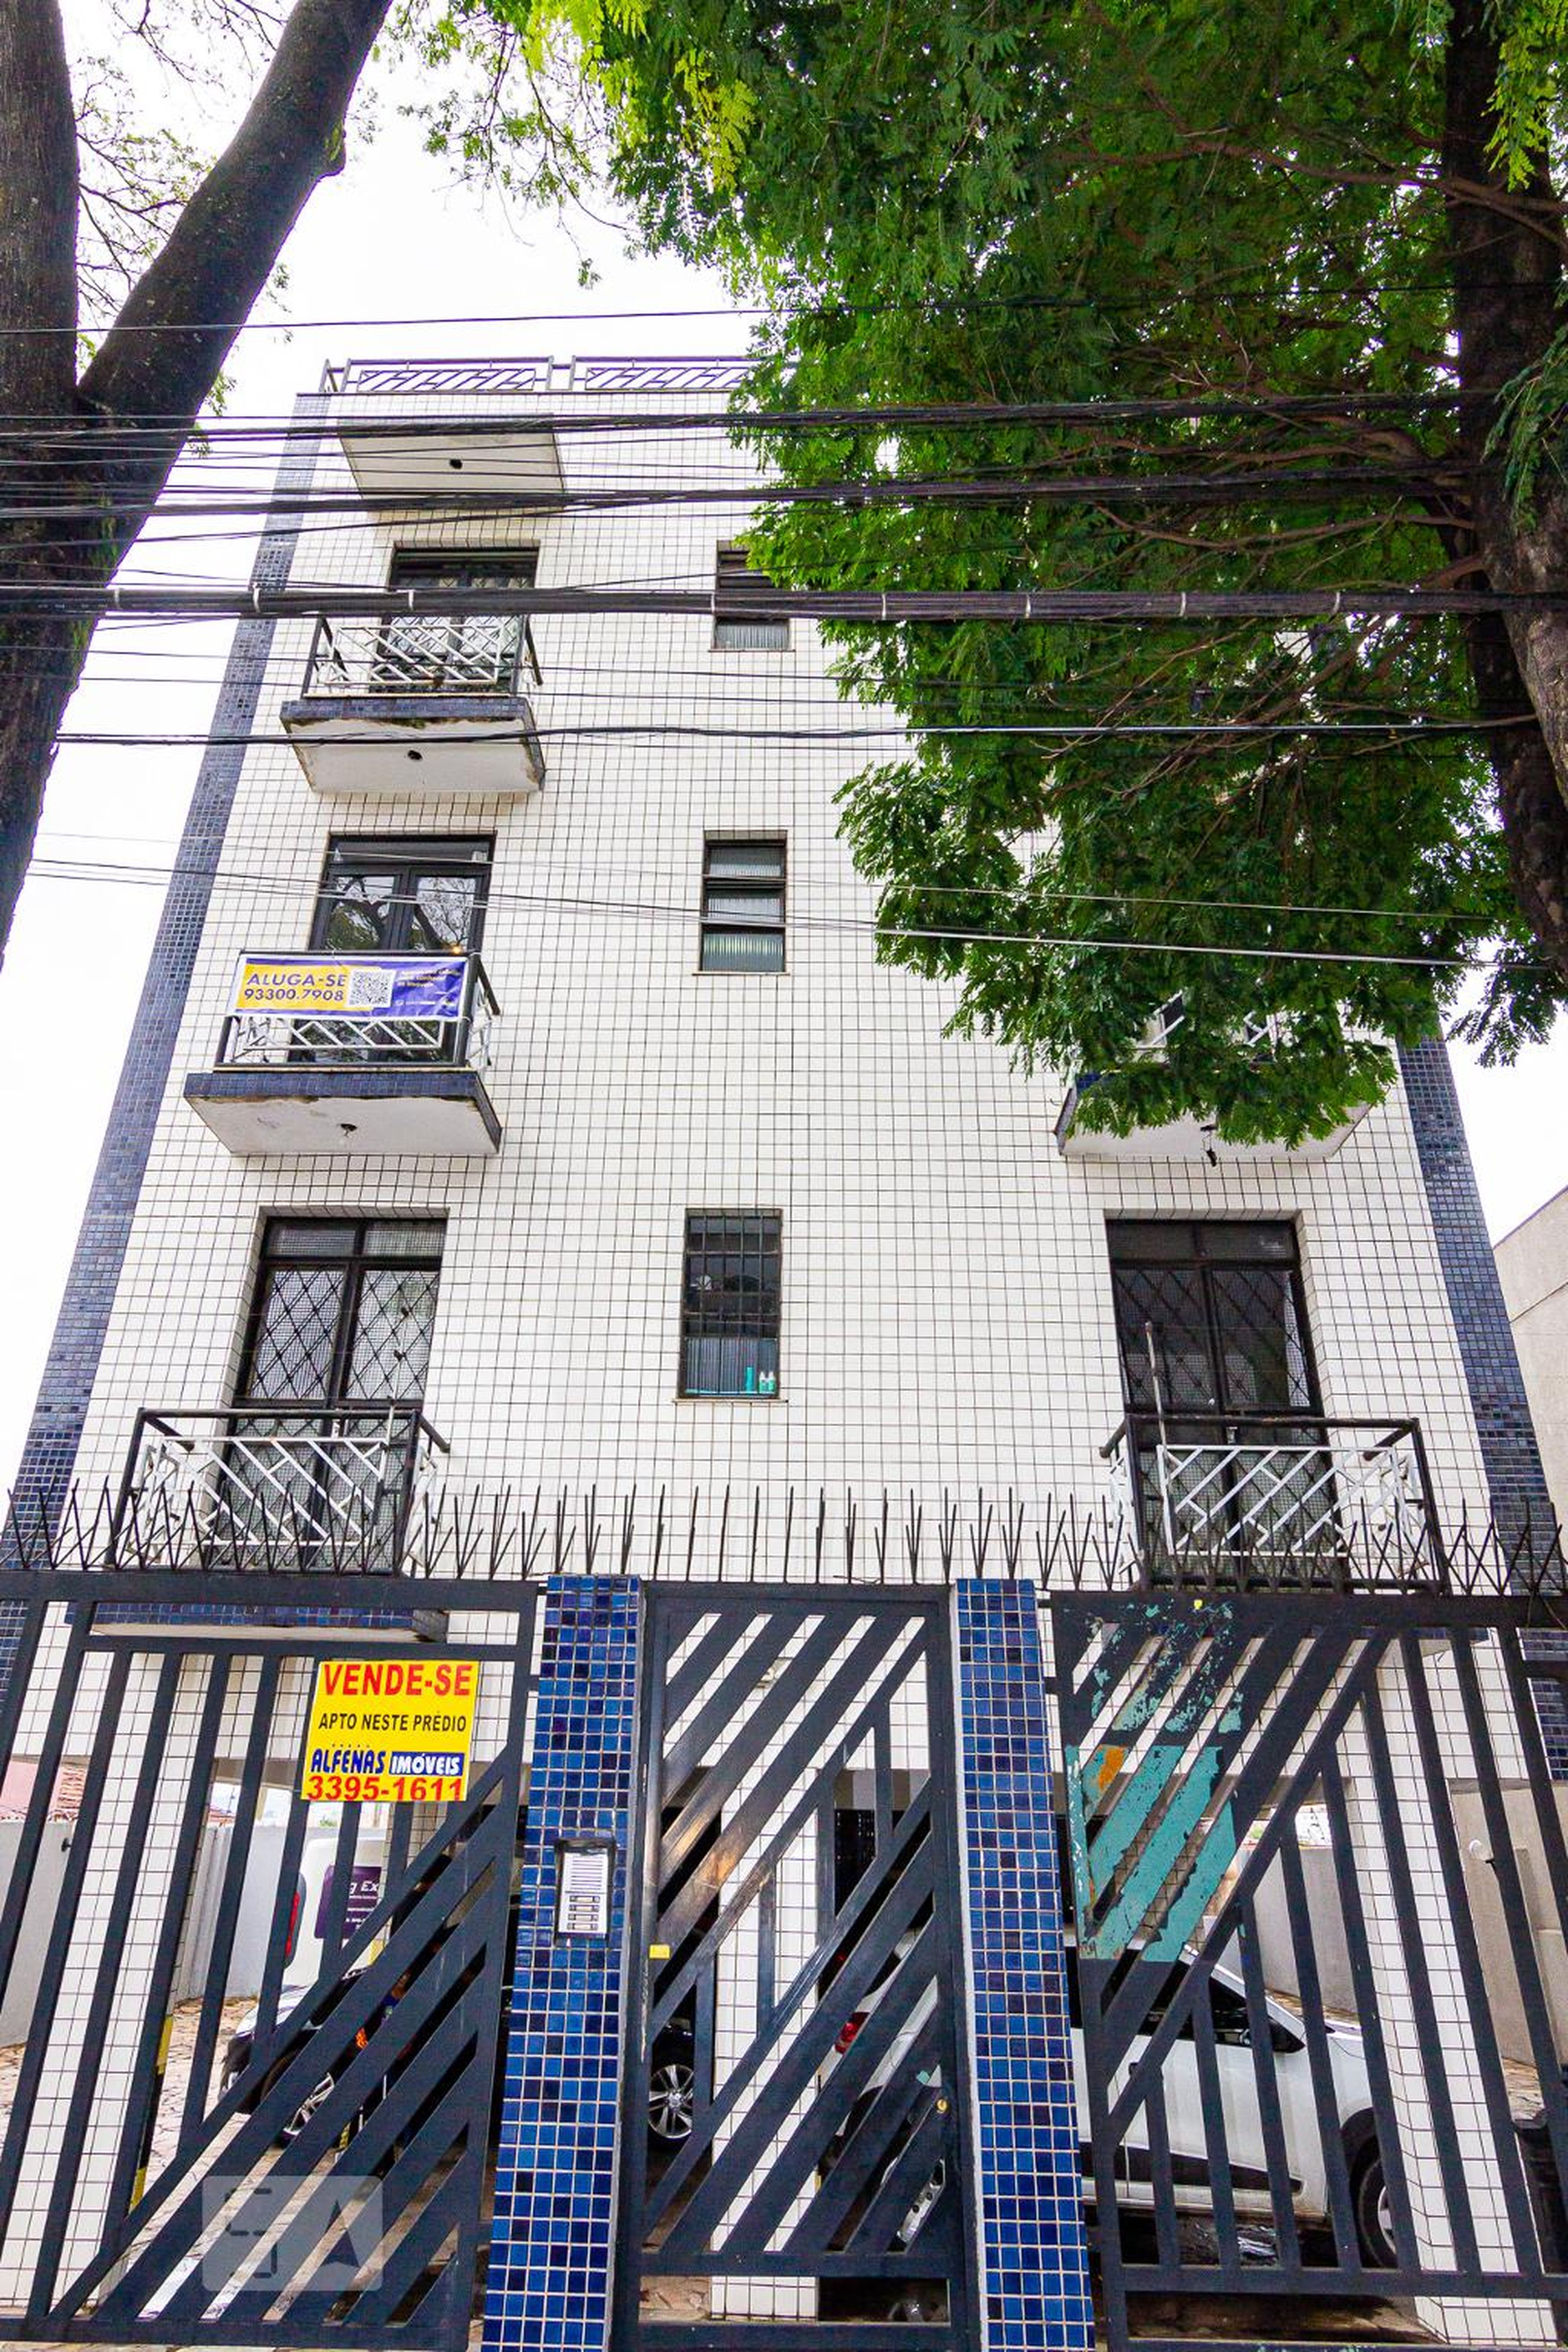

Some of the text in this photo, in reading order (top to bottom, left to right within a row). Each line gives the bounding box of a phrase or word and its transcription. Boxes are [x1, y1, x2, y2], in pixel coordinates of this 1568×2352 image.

[247, 973, 347, 987] ALUGA-SE
[245, 989, 344, 1001] 93300.7908
[325, 1664, 472, 1696] VENDE-SE
[318, 1713, 357, 1729] APTO
[362, 1714, 409, 1731] NESTE
[310, 1748, 461, 1775] ALFENAS IMÓVEIS
[307, 1775, 462, 1801] 3395-1611
